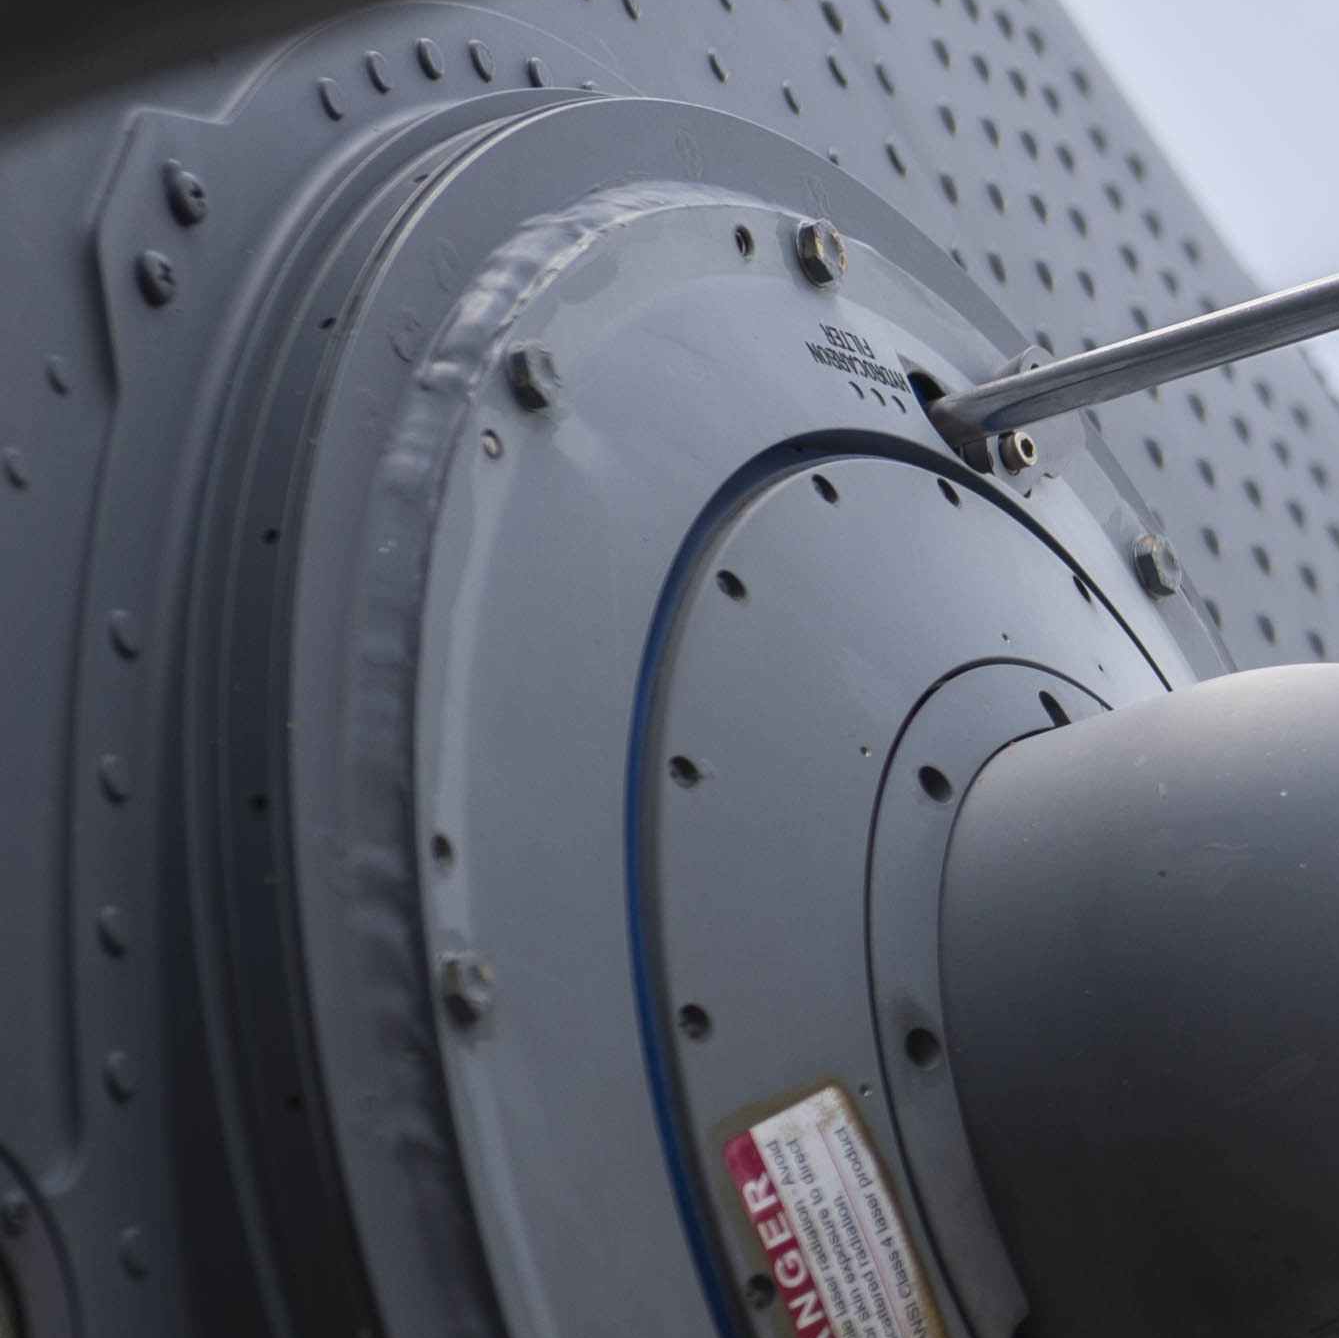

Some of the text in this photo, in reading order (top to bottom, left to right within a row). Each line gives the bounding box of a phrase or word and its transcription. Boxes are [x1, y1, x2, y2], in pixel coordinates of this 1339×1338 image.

[819, 322, 874, 359] FILTER
[805, 340, 910, 393] HYDROCARBON
[764, 1138, 795, 1184] Avoid
[784, 1137, 814, 1185] direct
[832, 1126, 872, 1189] product
[808, 1187, 823, 1206] to
[864, 1192, 888, 1235] laser
[793, 1198, 830, 1271] radiation
[817, 1207, 855, 1284] exposure
[878, 1236, 891, 1247] 4
[823, 1276, 846, 1317] laser
[887, 1249, 911, 1299] Class
[849, 1287, 870, 1322] skin
